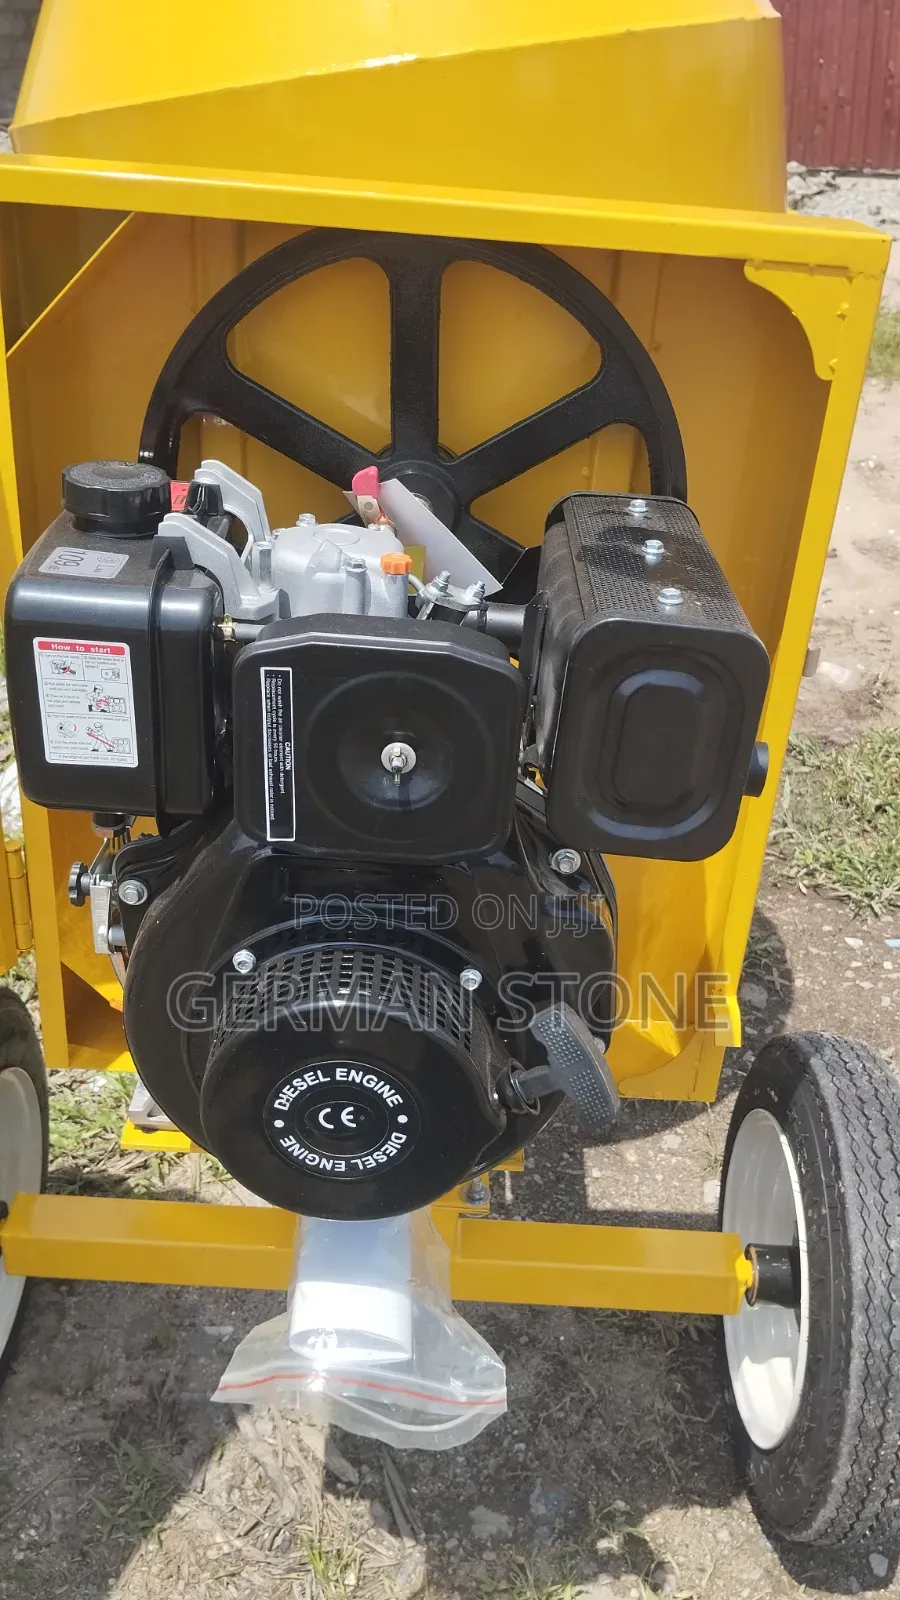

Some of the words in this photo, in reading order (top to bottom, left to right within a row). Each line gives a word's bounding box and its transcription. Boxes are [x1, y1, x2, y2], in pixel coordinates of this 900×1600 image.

[51, 643, 71, 651] How
[90, 646, 111, 654] start
[273, 1069, 331, 1111] DIESEL
[335, 1067, 404, 1108] ENGINE
[318, 1106, 357, 1130] CE
[279, 1134, 347, 1172] ENGINE
[350, 1131, 407, 1171] DIESEL
